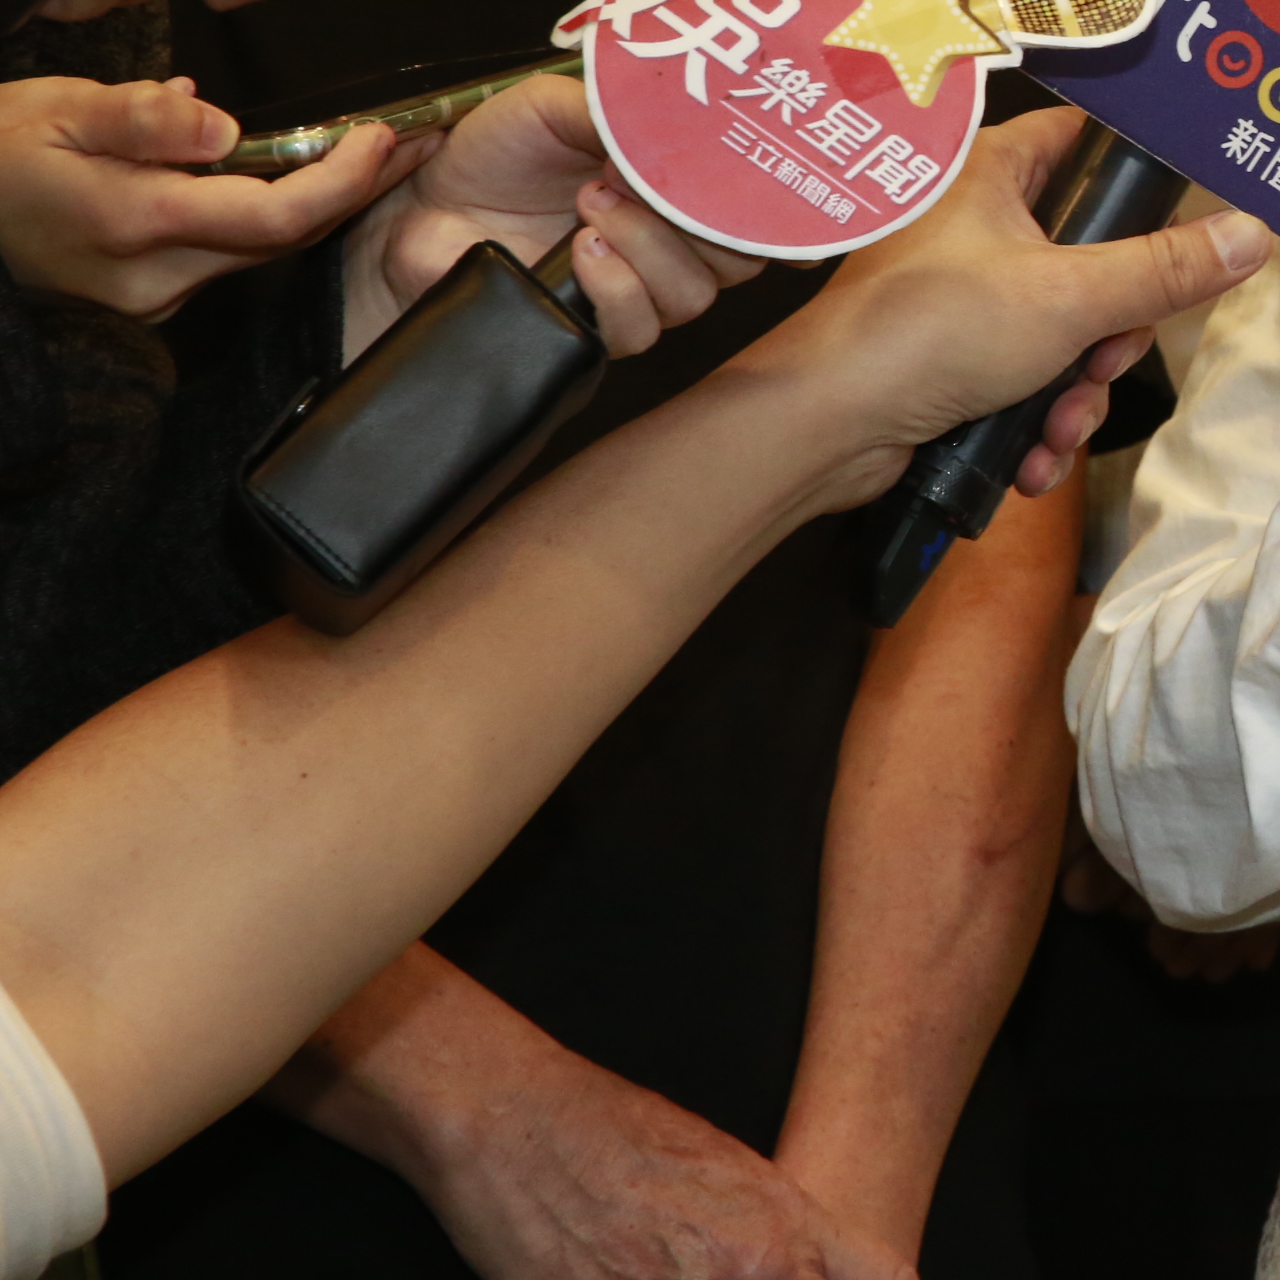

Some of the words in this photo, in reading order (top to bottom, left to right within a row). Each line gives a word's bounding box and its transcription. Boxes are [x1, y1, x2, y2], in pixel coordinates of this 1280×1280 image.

[720, 120, 857, 226] 三立新聞網
